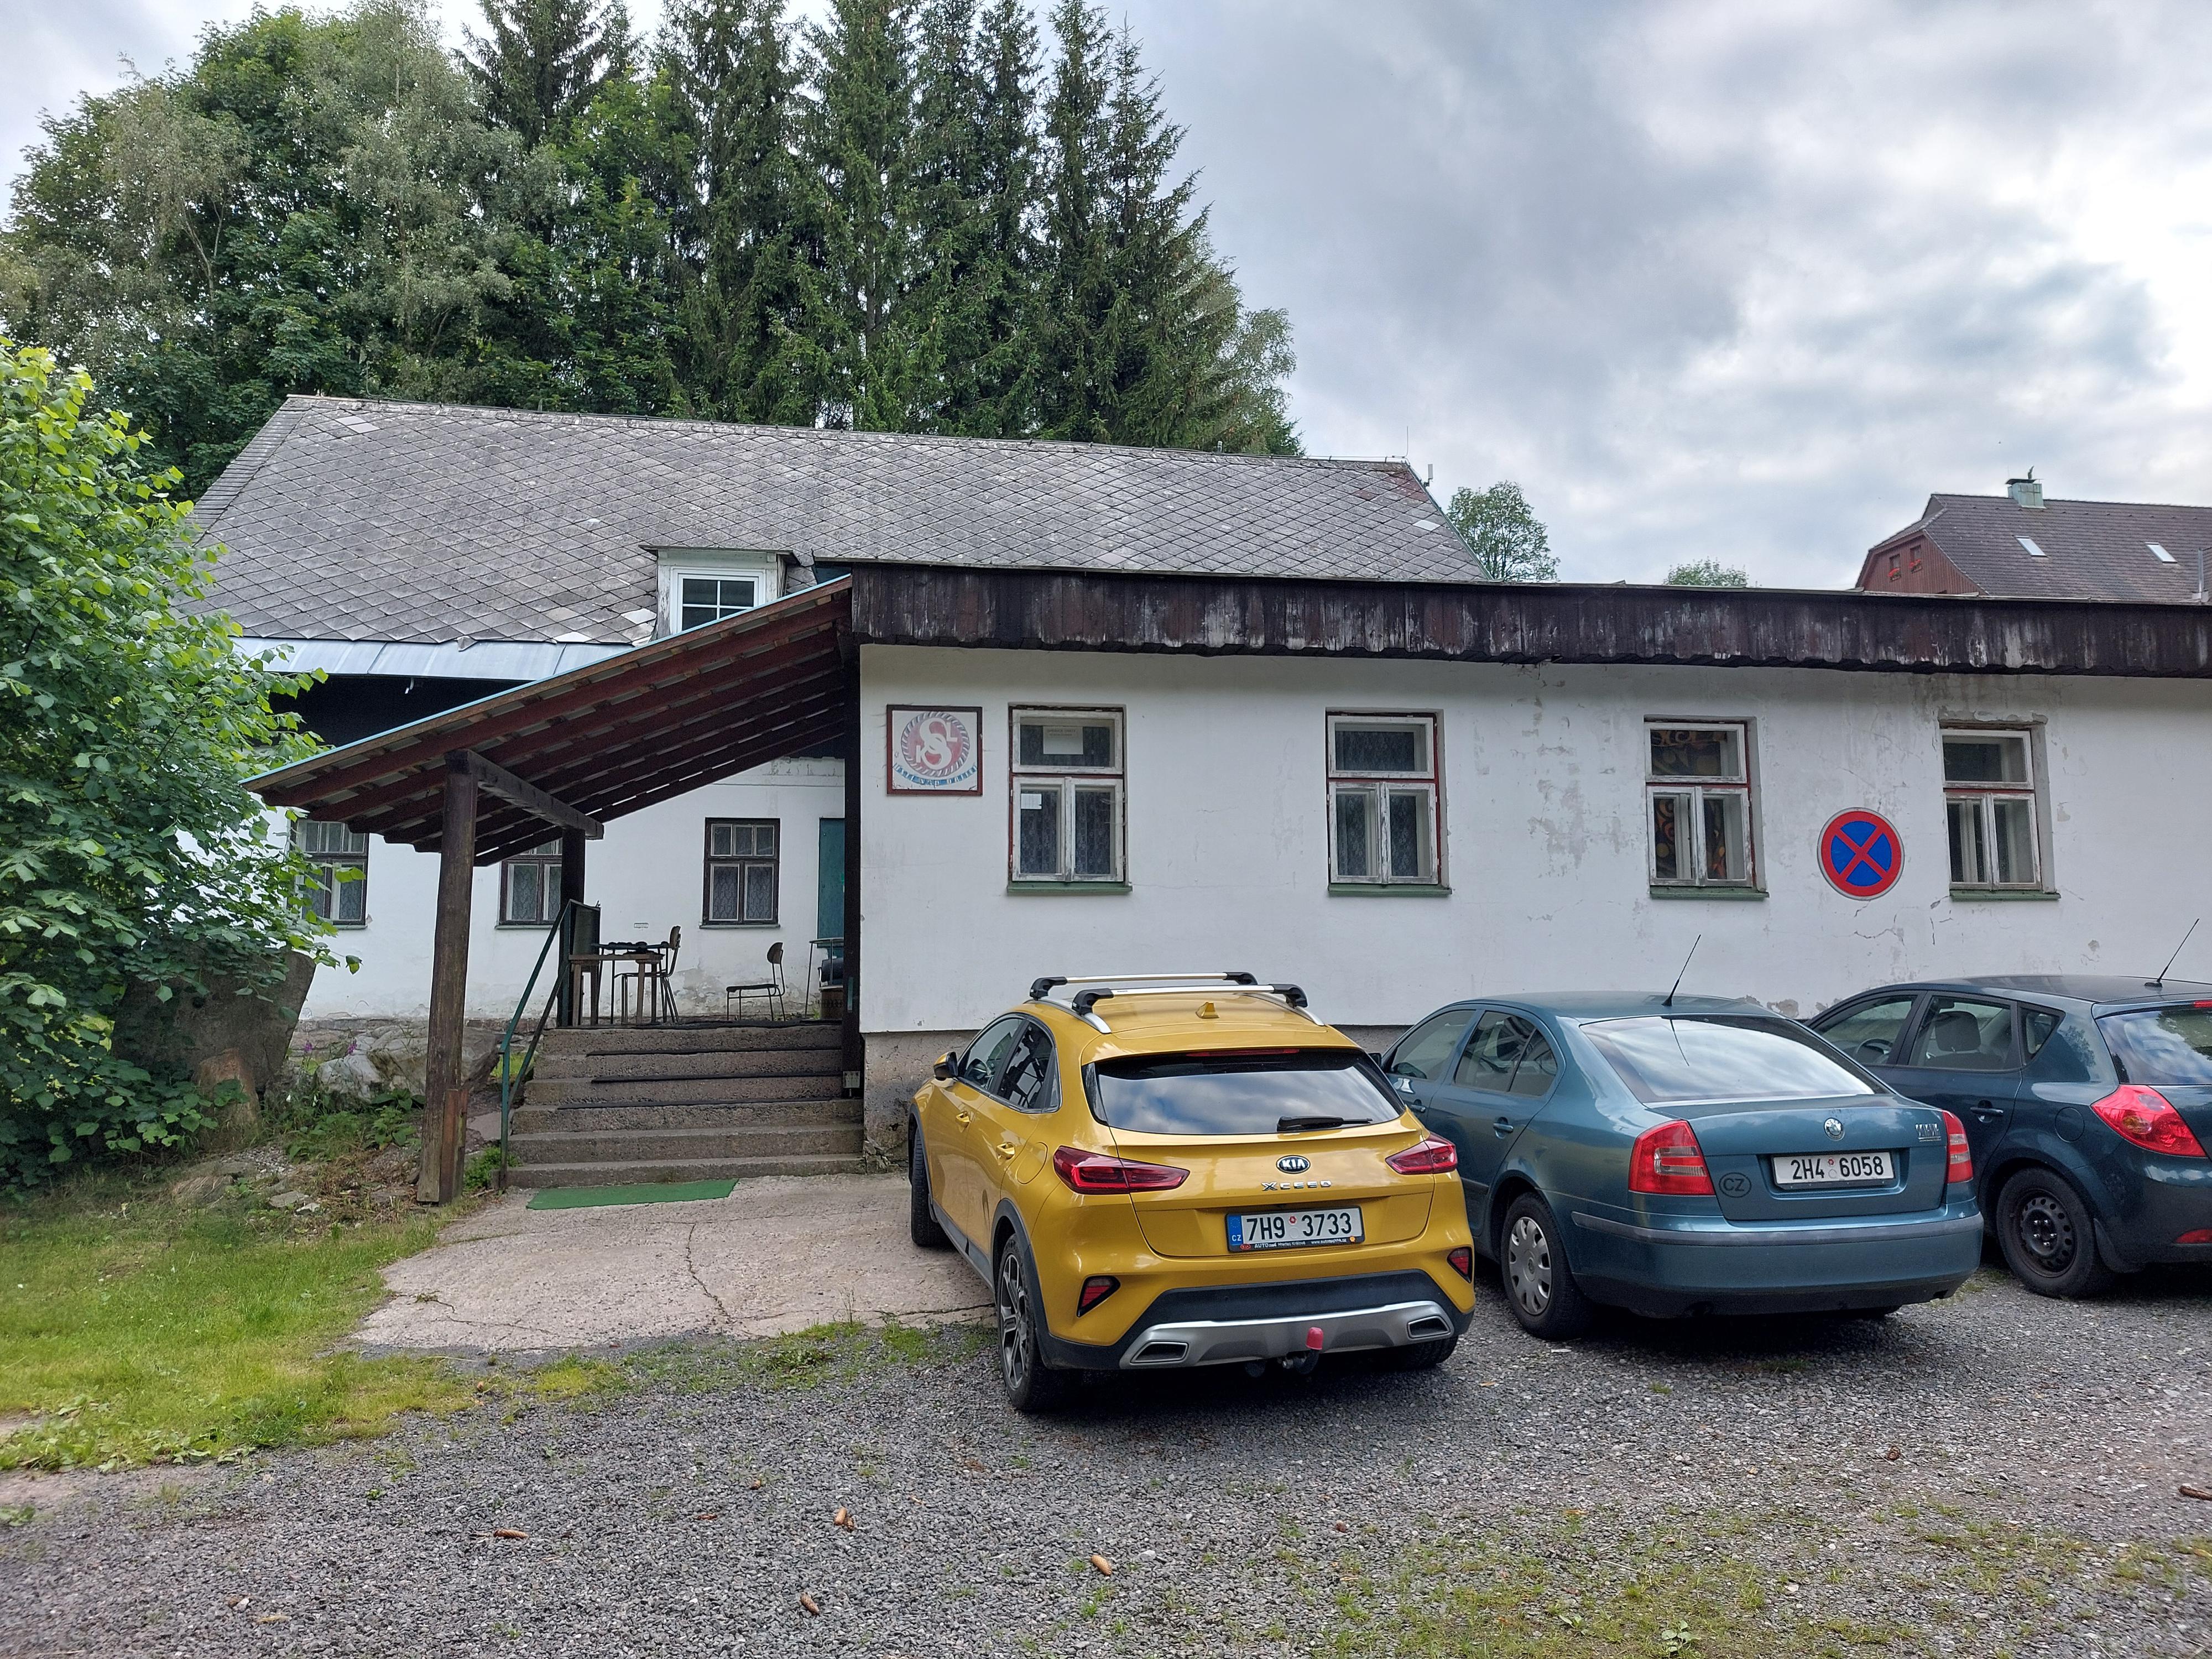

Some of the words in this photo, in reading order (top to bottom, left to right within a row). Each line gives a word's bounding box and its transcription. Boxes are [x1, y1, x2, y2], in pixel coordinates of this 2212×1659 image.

[1281, 1159, 1306, 1170] KIA
[1791, 1158, 1825, 1180] 2H4
[1839, 1156, 1884, 1177] 6058
[1261, 1180, 1332, 1191] XCEED
[1723, 1178, 1745, 1191] CZ
[1246, 1216, 1285, 1241] 7H9
[1301, 1212, 1352, 1237] 3733
